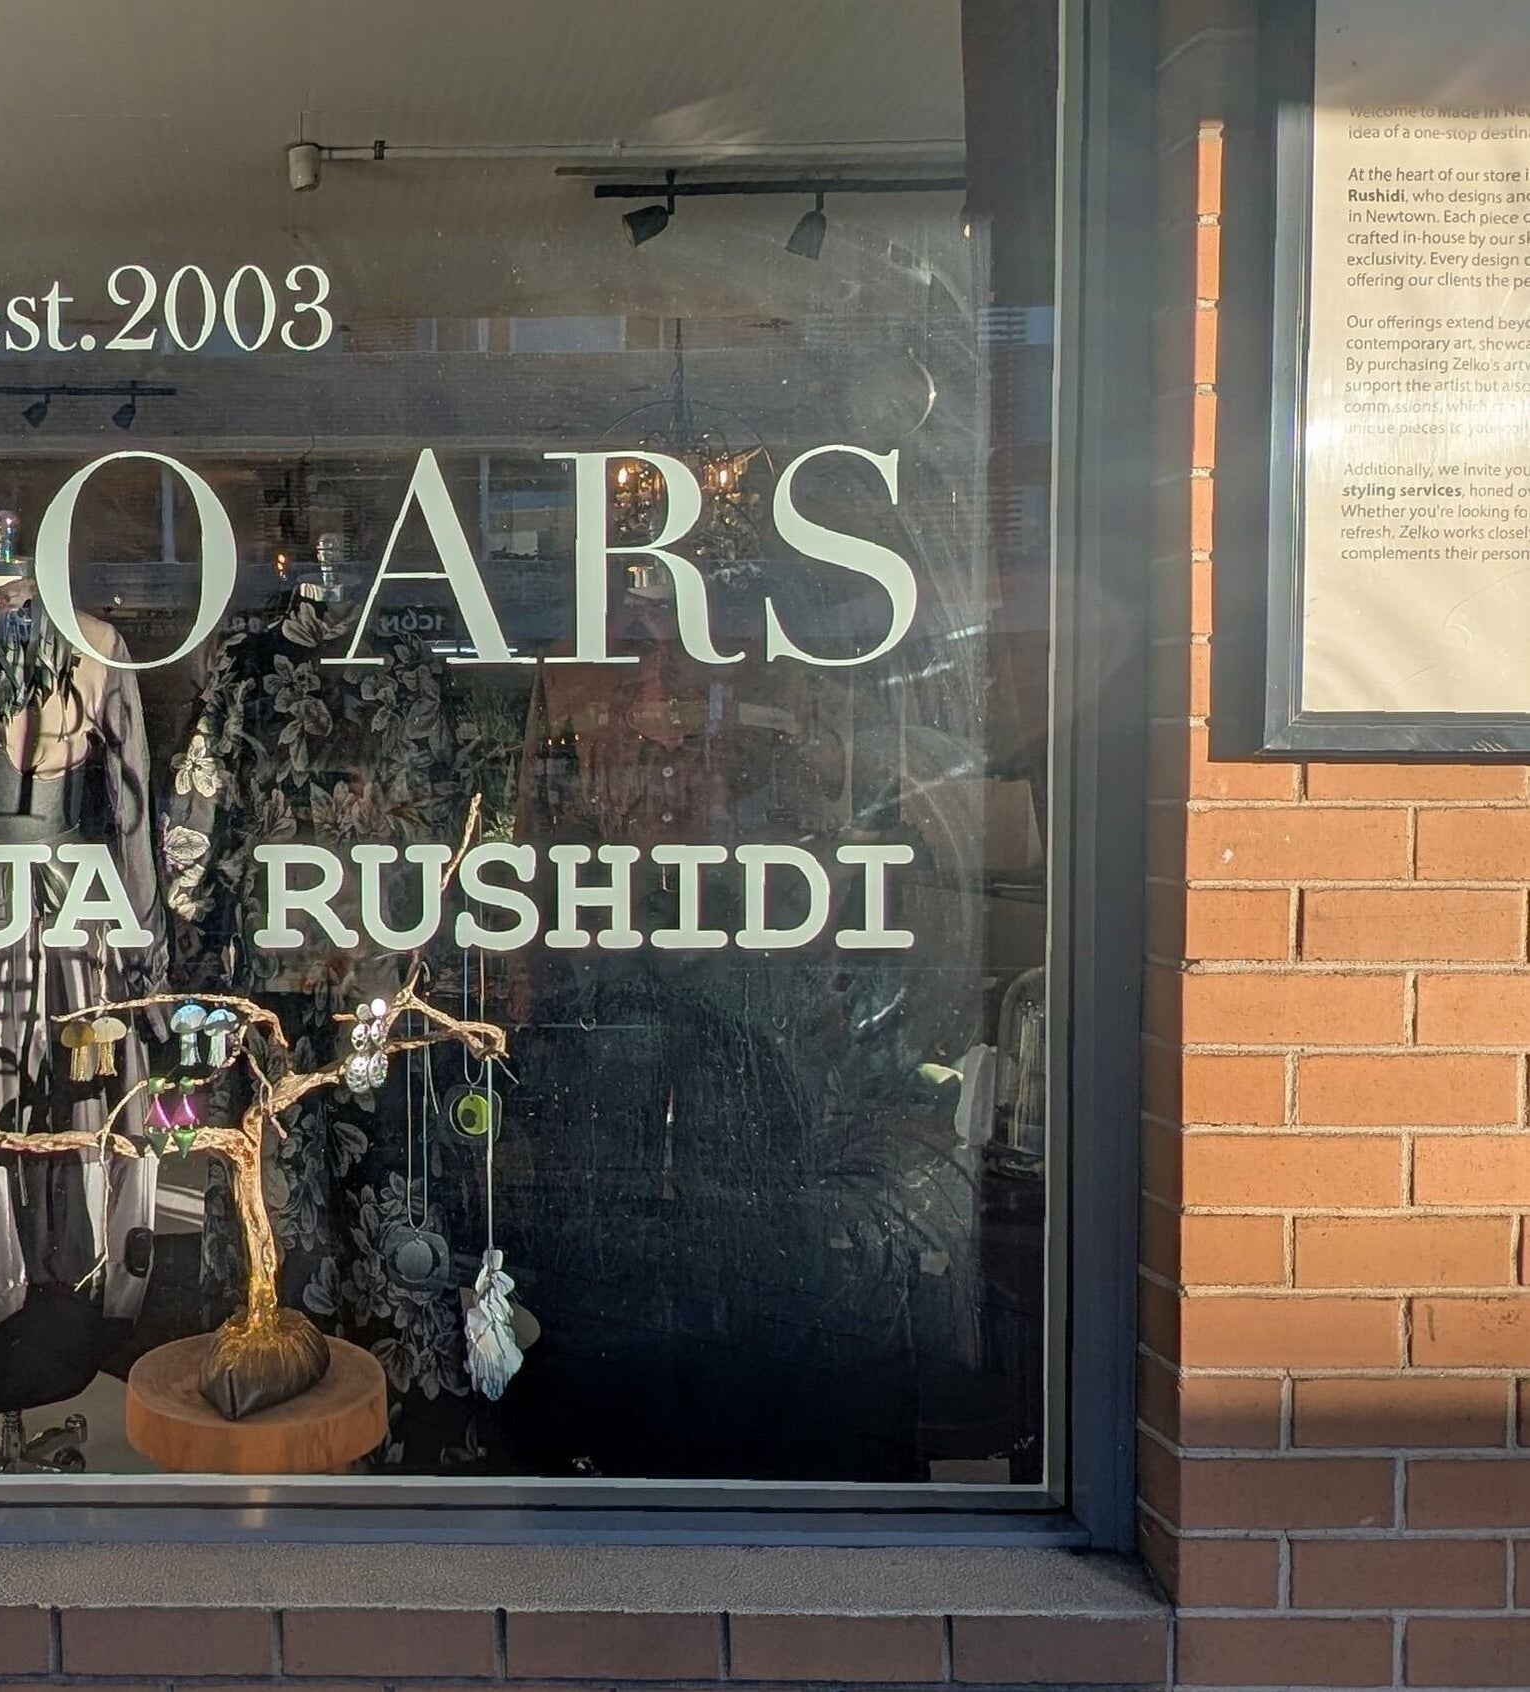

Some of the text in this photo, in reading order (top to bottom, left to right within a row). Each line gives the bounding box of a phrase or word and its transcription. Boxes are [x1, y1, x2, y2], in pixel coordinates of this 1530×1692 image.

[1504, 105, 1530, 119] Ne
[1481, 125, 1530, 142] destin
[1348, 168, 1365, 183] At
[1368, 166, 1393, 183] the
[1396, 167, 1434, 182] heart
[1438, 168, 1454, 181] of
[1456, 172, 1480, 183] our
[1483, 170, 1521, 182] store
[1348, 188, 1408, 203] Rushidi,
[1412, 188, 1444, 203] who
[1448, 189, 1503, 205] designs
[1349, 209, 1362, 222] in
[1366, 209, 1439, 225] Newtown.
[1444, 209, 1475, 223] Each
[1478, 209, 1520, 225] piece
[1347, 230, 1399, 245] crafted
[1403, 230, 1465, 245] in-house
[1469, 230, 1486, 248] by
[1488, 234, 1515, 245] our
[1347, 251, 1426, 269] exclusivity.
[1430, 251, 1468, 269] Every
[1472, 252, 1519, 269] design
[1347, 273, 1404, 290] offering
[1407, 275, 1433, 287] our
[1436, 272, 1483, 288] clients
[1484, 273, 1510, 287] the
[1347, 315, 1374, 328] Our
[1377, 315, 1442, 332] offerings
[1445, 315, 1494, 329] extend
[1346, 338, 1451, 353] contemporary
[1453, 338, 1476, 351] art,
[1347, 357, 1364, 373] By
[1368, 357, 1448, 373] purchasing
[1452, 357, 1500, 371] Zelko's
[1344, 377, 1402, 394] support
[1405, 378, 1431, 392] the
[1434, 379, 1471, 392] artist
[1475, 378, 1499, 392] but
[1399, 420, 1446, 437] pieces
[1344, 462, 1434, 479] Additionally,
[1438, 466, 1460, 475] we
[1463, 463, 1501, 475] invite
[1342, 483, 1396, 500] styling
[1400, 483, 1465, 498] services,
[1470, 483, 1514, 498] honed
[1341, 505, 1407, 518] Whether
[1408, 504, 1454, 521] you're
[1458, 504, 1509, 521] looking
[1341, 525, 1530, 541] refresh, Zelko works closel
[320, 444, 918, 667] ARS
[1341, 547, 1440, 562] complements
[1444, 547, 1477, 560] their
[254, 842, 916, 951] RUSHIDI
